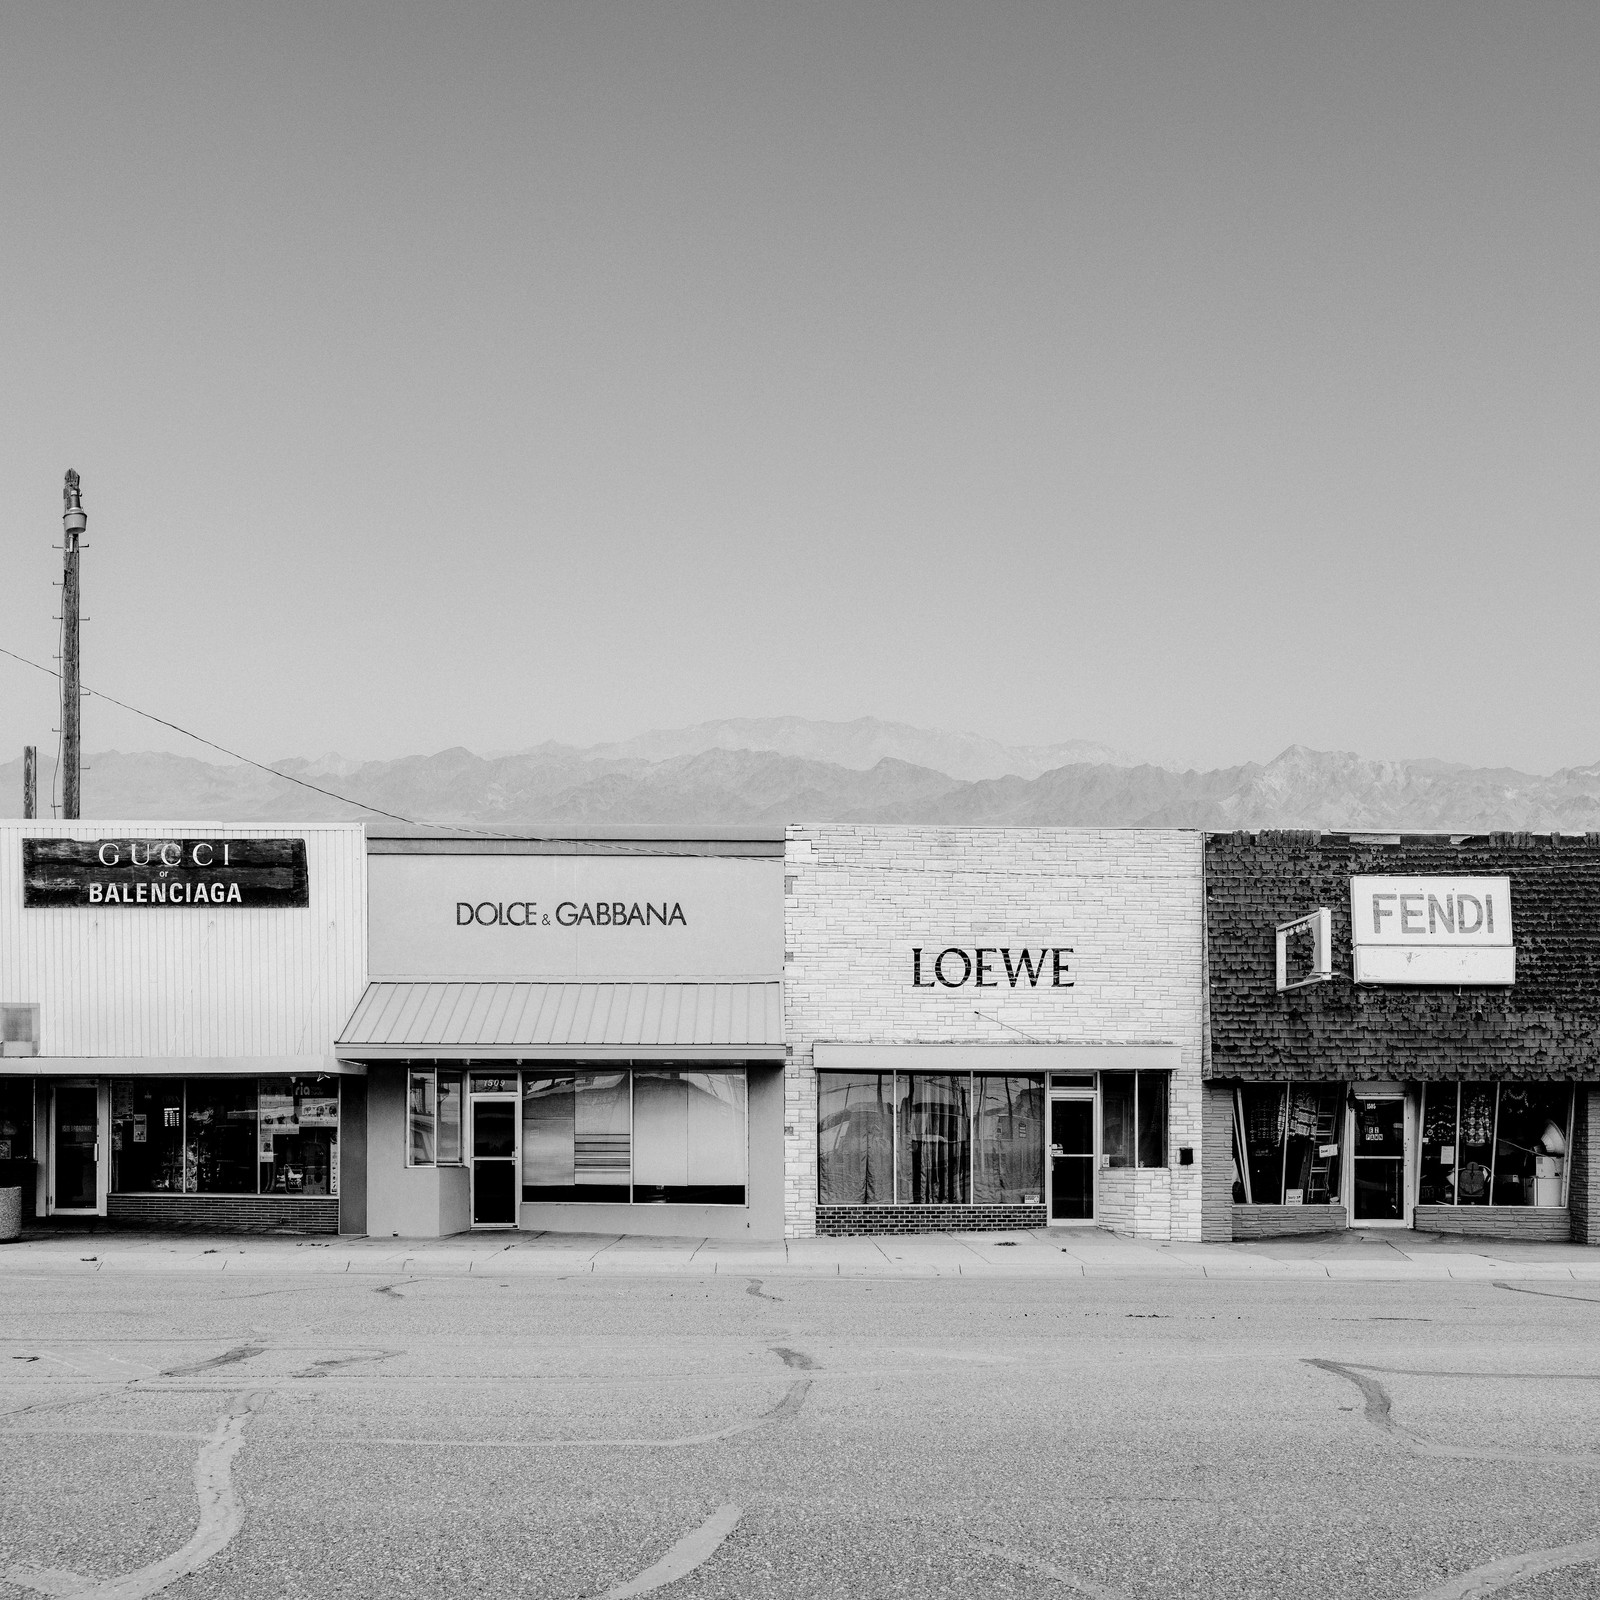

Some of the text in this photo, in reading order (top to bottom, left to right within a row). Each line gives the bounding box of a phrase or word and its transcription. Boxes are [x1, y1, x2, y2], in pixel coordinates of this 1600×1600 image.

[98, 843, 230, 866] GUCCI
[159, 870, 169, 878] or
[89, 882, 242, 903] BALENCIAGA
[456, 902, 687, 926] DOLCE & GABBANA
[1372, 892, 1495, 934] FENDI
[911, 947, 1075, 988] LOEWE
[483, 1078, 506, 1087] 1509
